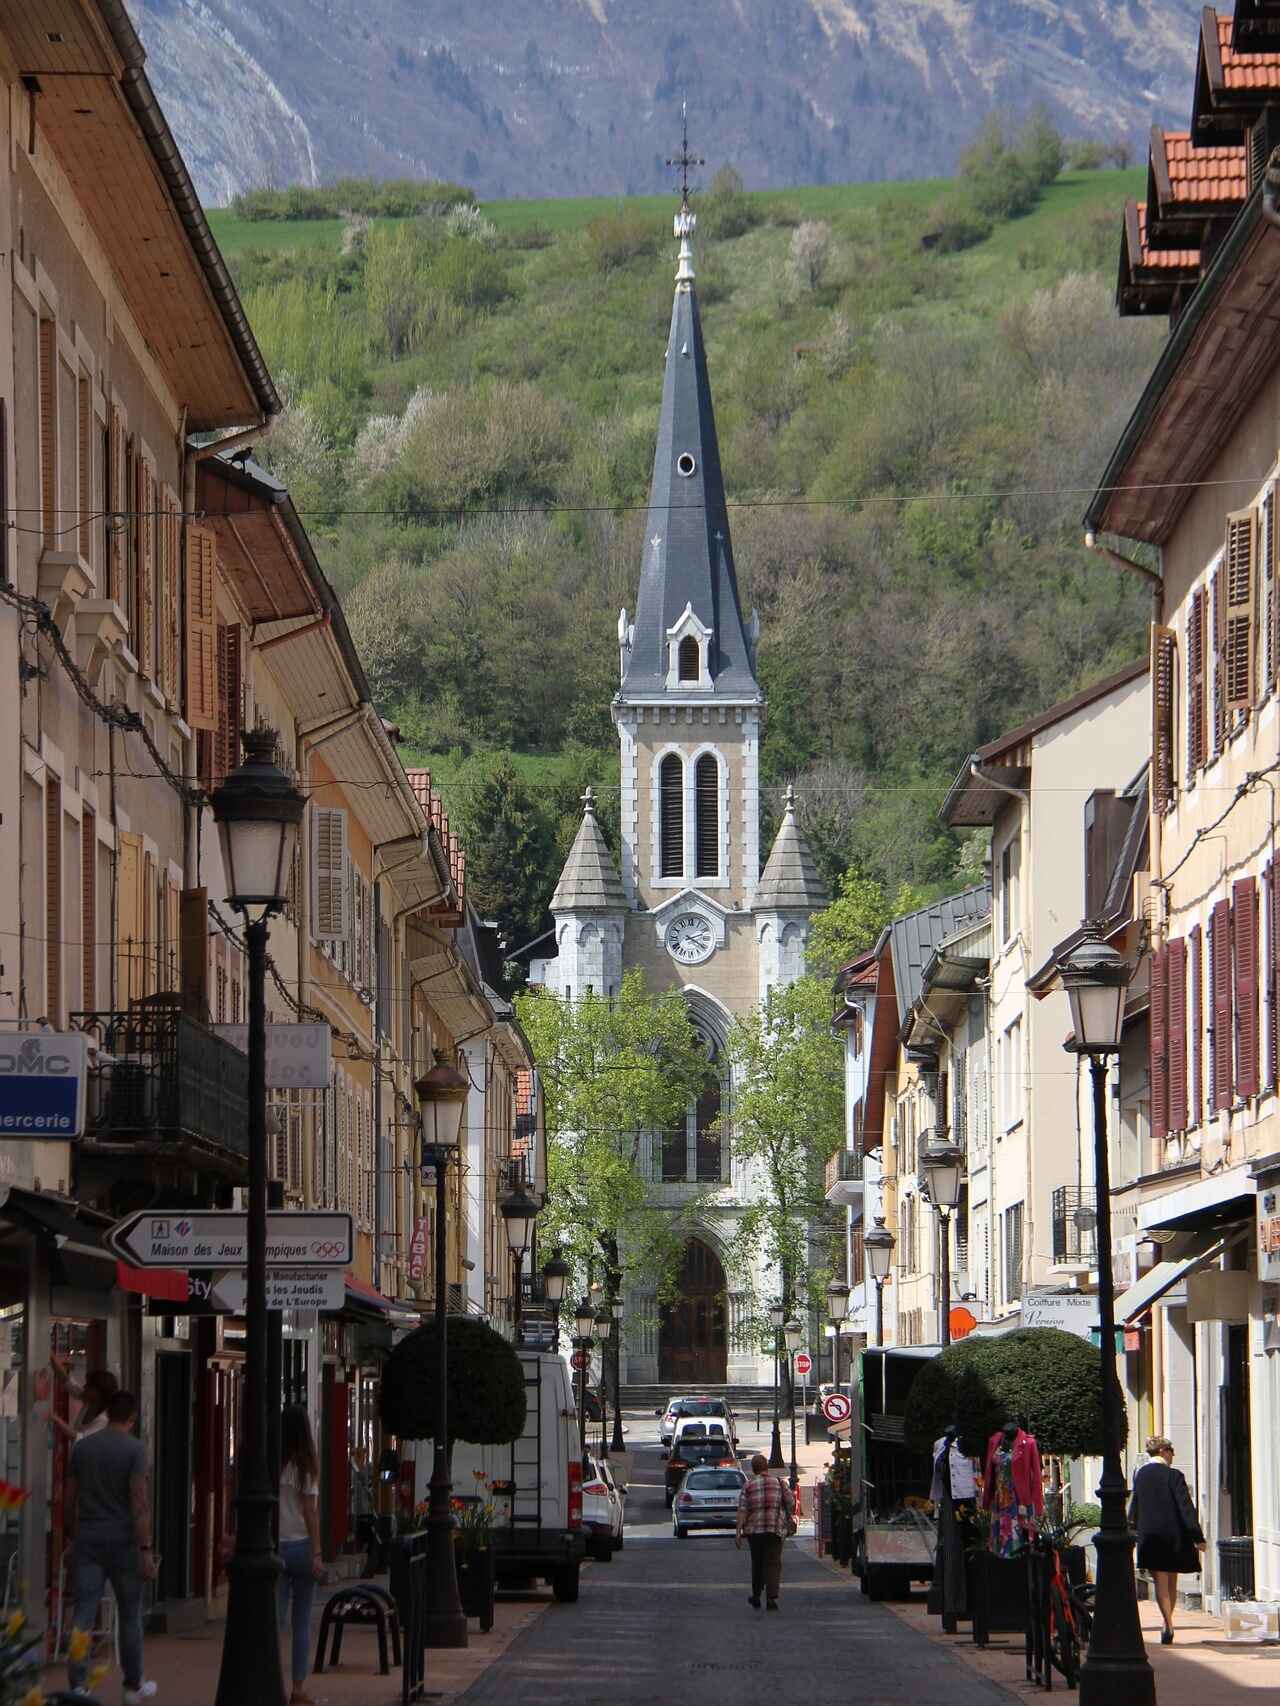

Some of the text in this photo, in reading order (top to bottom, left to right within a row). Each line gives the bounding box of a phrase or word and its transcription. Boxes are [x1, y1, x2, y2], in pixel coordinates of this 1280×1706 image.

[0, 1113, 71, 1128] ercerie
[151, 1242, 308, 1259] Maison des Jeux mpiques
[411, 1216, 428, 1280] TABAC
[273, 1271, 329, 1281] Manufacturier
[273, 1284, 288, 1295] les
[291, 1284, 324, 1295] Jeudis
[272, 1298, 283, 1306] de
[286, 1298, 328, 1308] L'Europe
[1027, 1298, 1061, 1307] Coiffure
